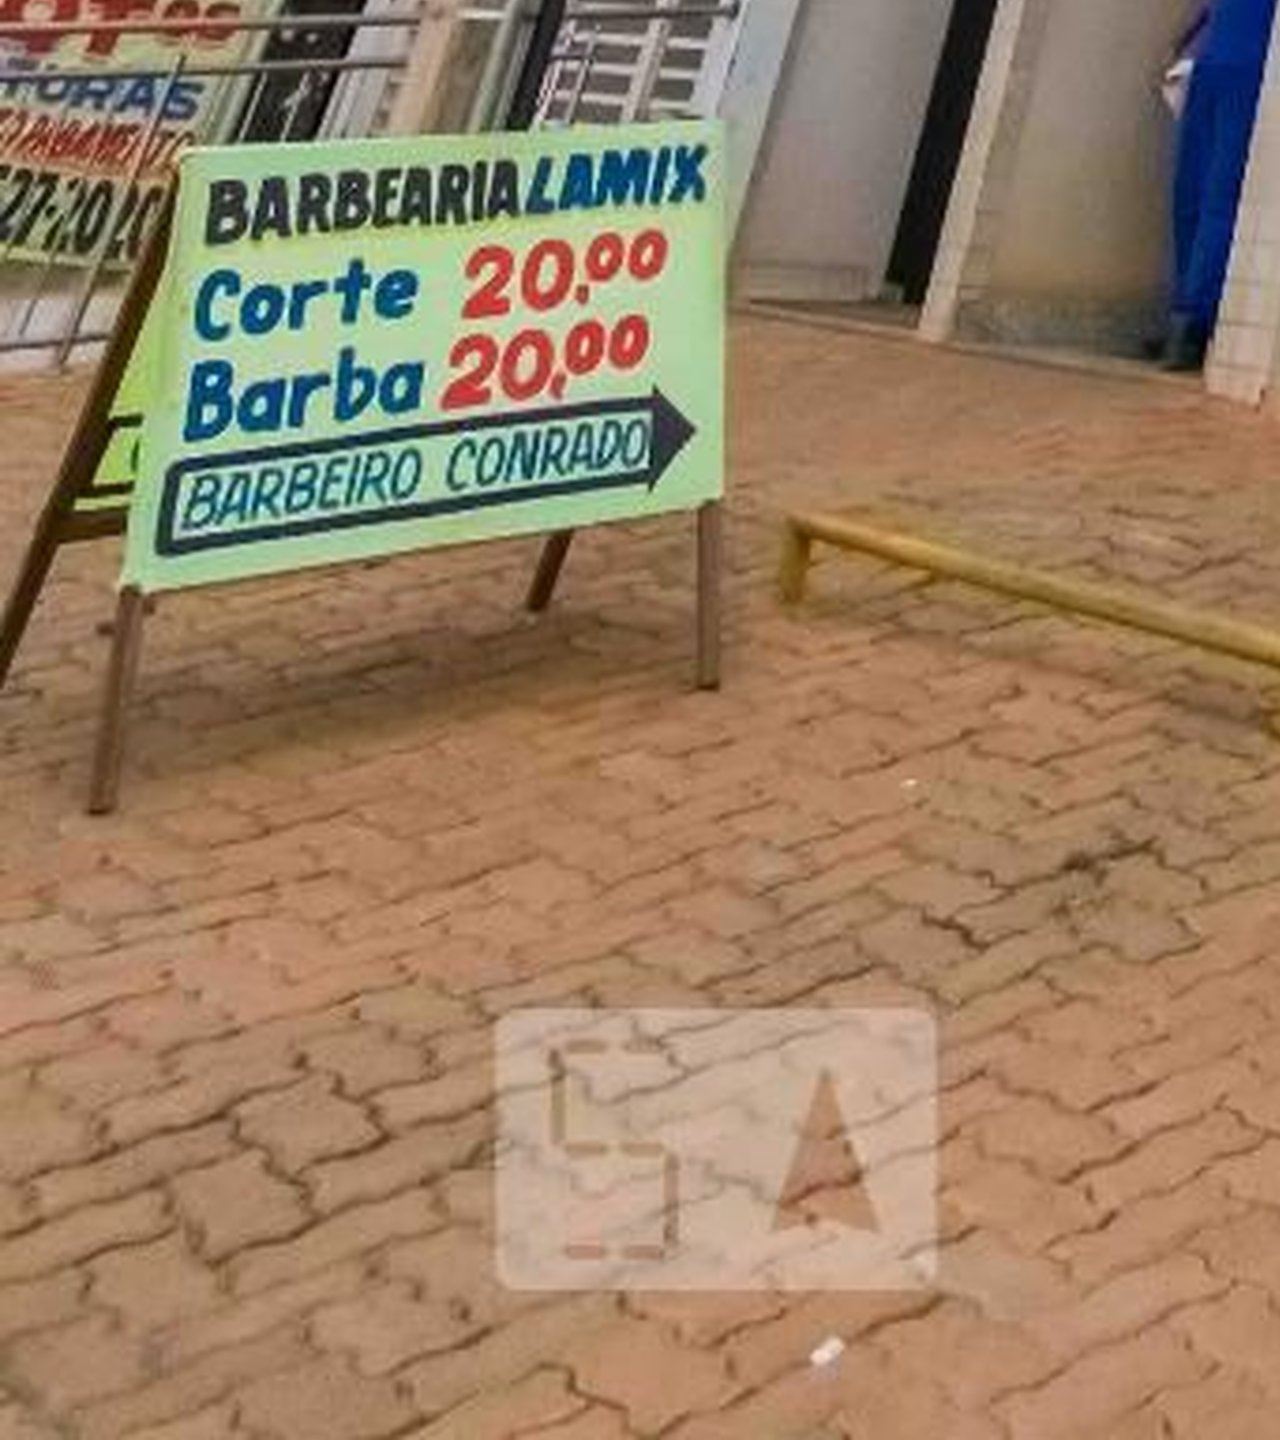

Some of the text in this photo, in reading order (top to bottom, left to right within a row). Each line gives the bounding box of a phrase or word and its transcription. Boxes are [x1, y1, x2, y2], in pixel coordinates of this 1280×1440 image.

[205, 142, 709, 246] BARBEARIA LAMIX
[194, 258, 419, 341] Corte
[183, 347, 425, 443] Barba
[182, 418, 648, 528] BARBEIRO CONRADO
